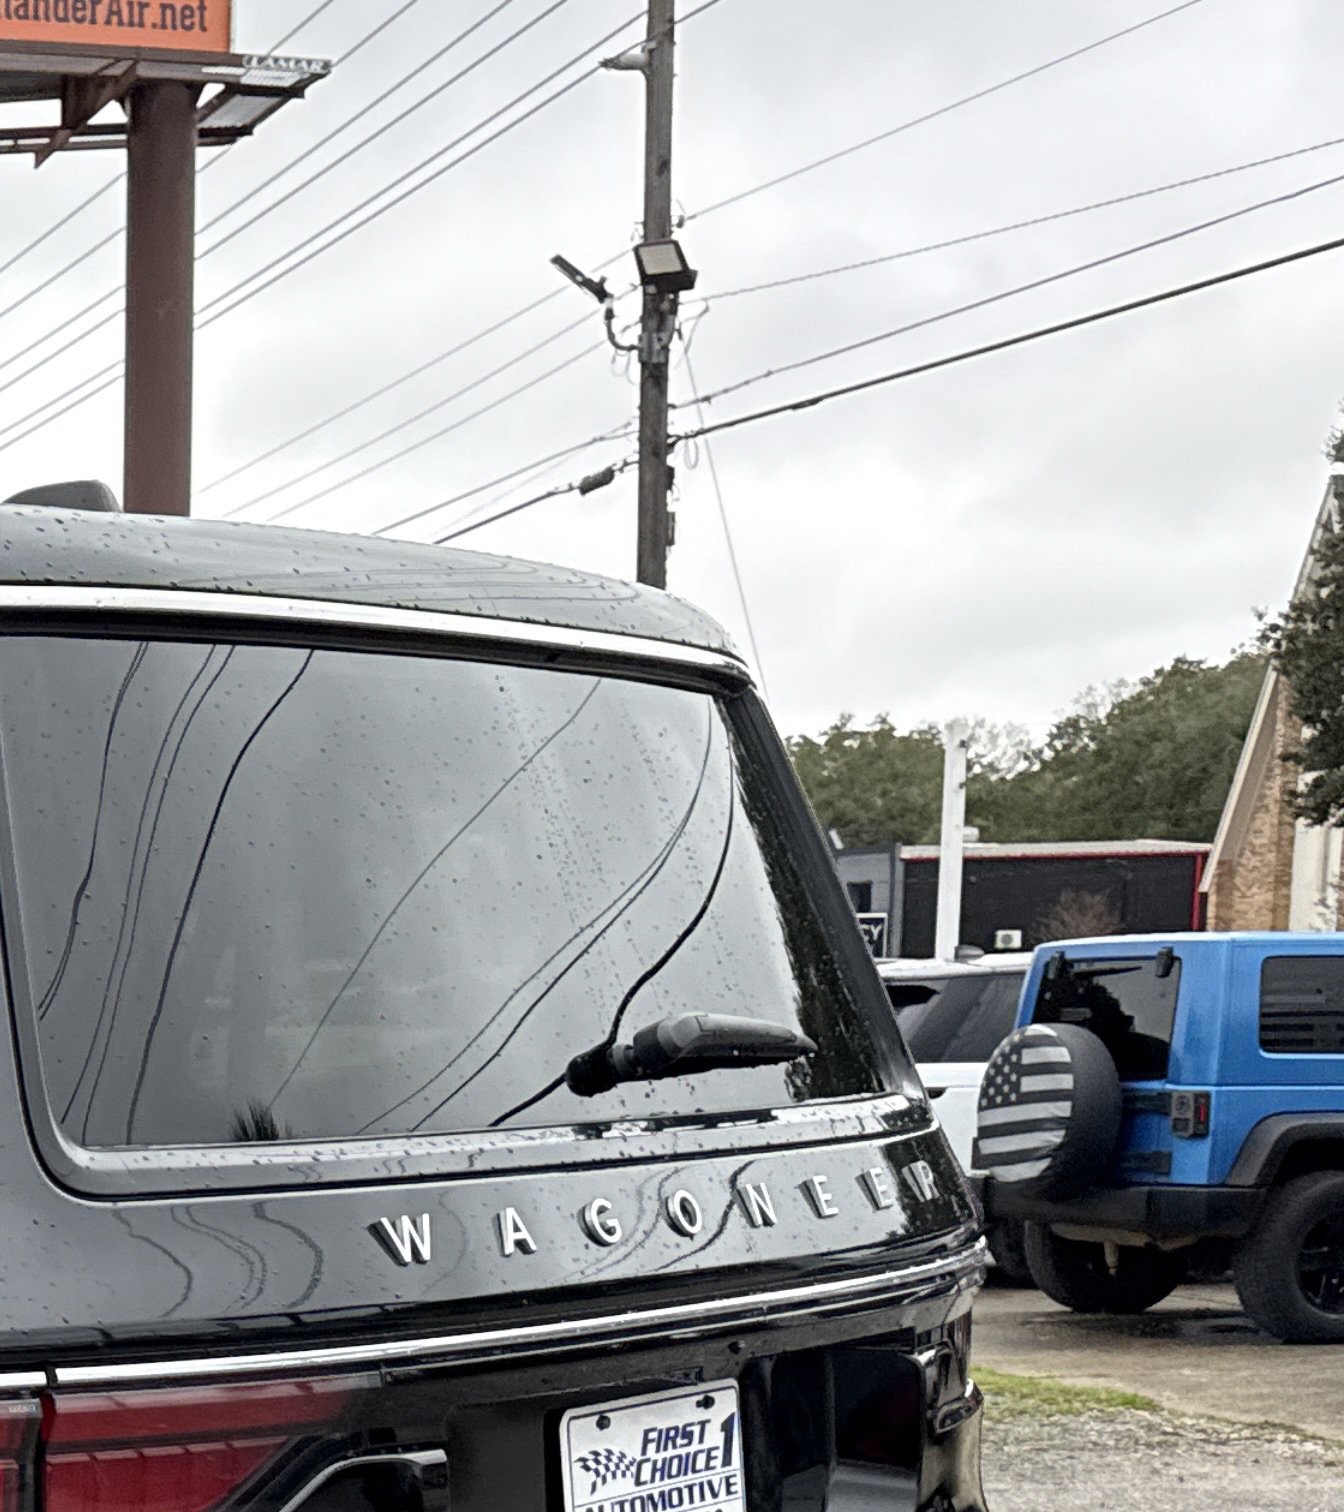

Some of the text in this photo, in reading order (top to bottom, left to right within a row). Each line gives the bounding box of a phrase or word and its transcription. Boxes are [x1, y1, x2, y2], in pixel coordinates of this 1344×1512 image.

[376, 1160, 941, 1266] WAGONEER
[634, 1412, 736, 1487] CHOICE 1
[640, 1419, 711, 1456] FIRST
